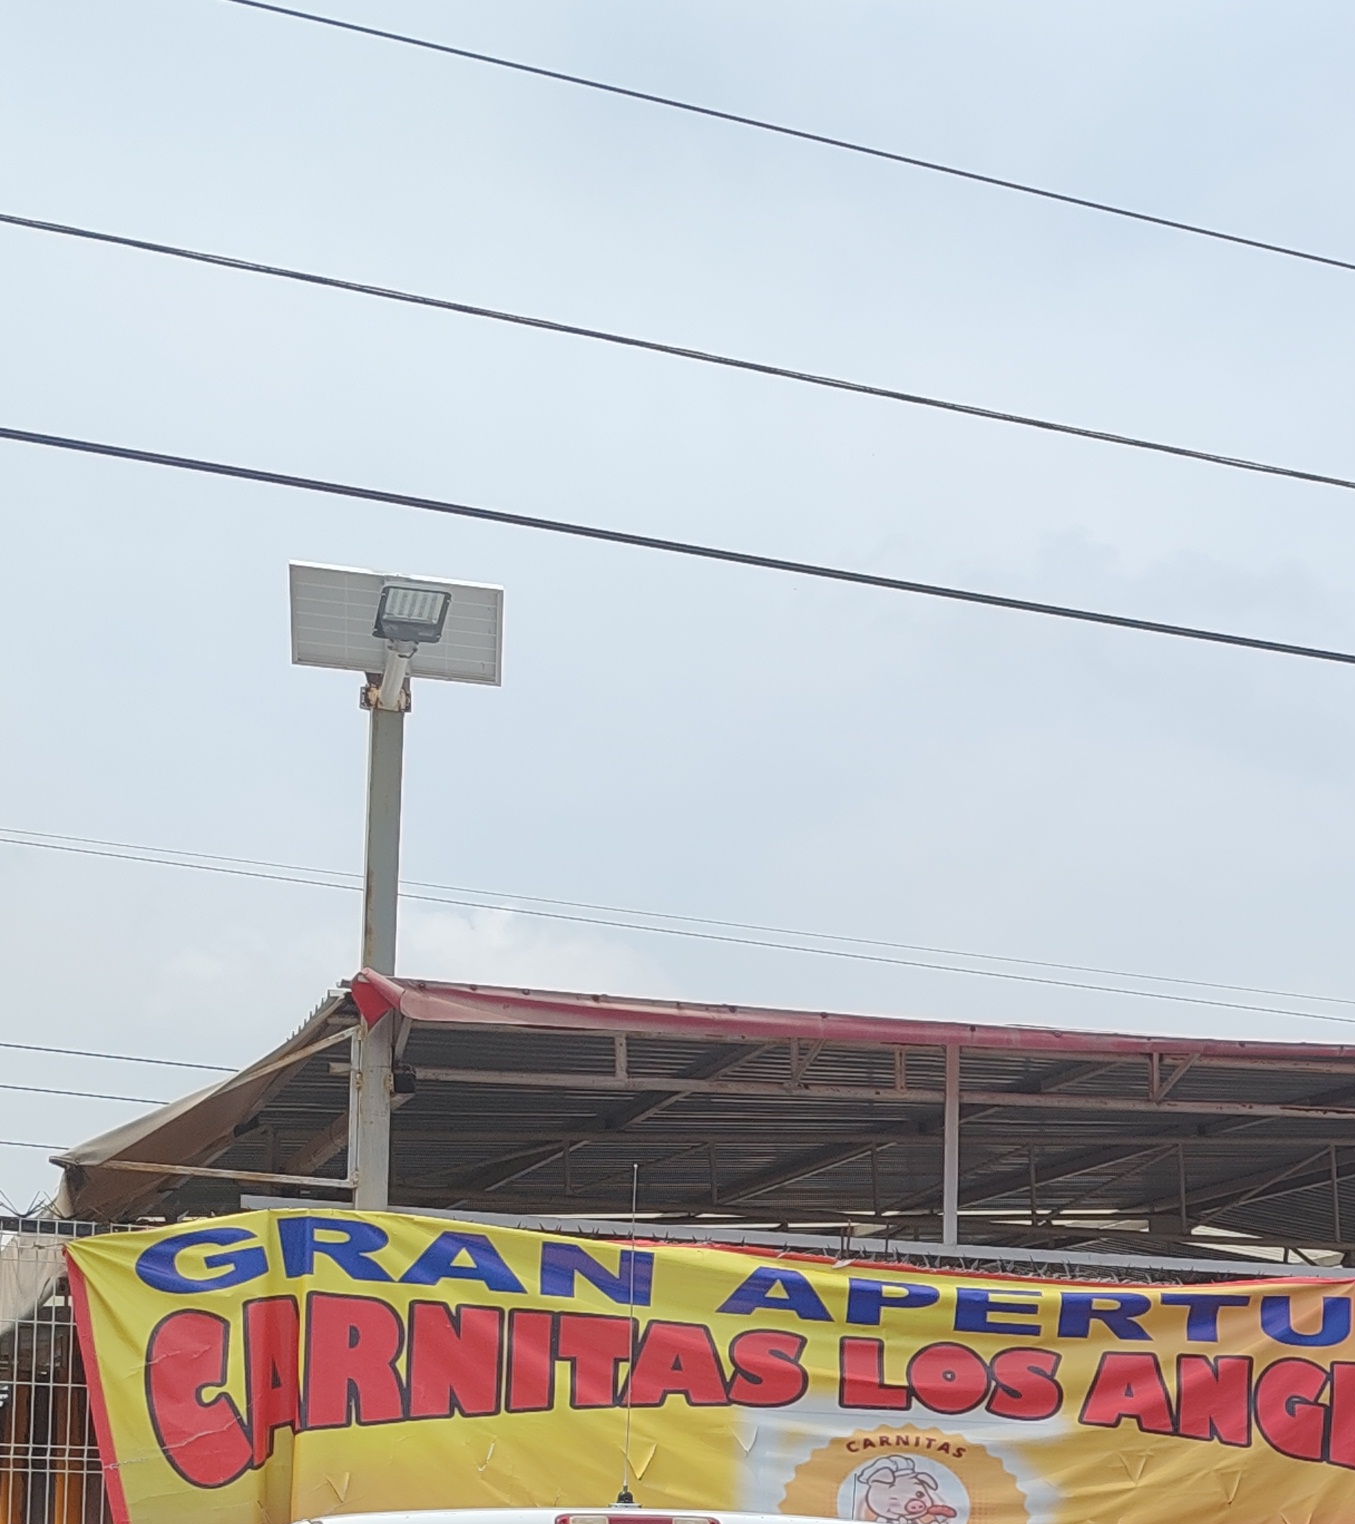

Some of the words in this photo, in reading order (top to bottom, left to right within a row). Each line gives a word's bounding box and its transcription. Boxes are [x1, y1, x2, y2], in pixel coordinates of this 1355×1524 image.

[135, 1216, 654, 1307] GRAN
[145, 1291, 810, 1488] CARNITAS
[838, 1336, 1064, 1421] LOS
[845, 1434, 967, 1459] CARNITAS
